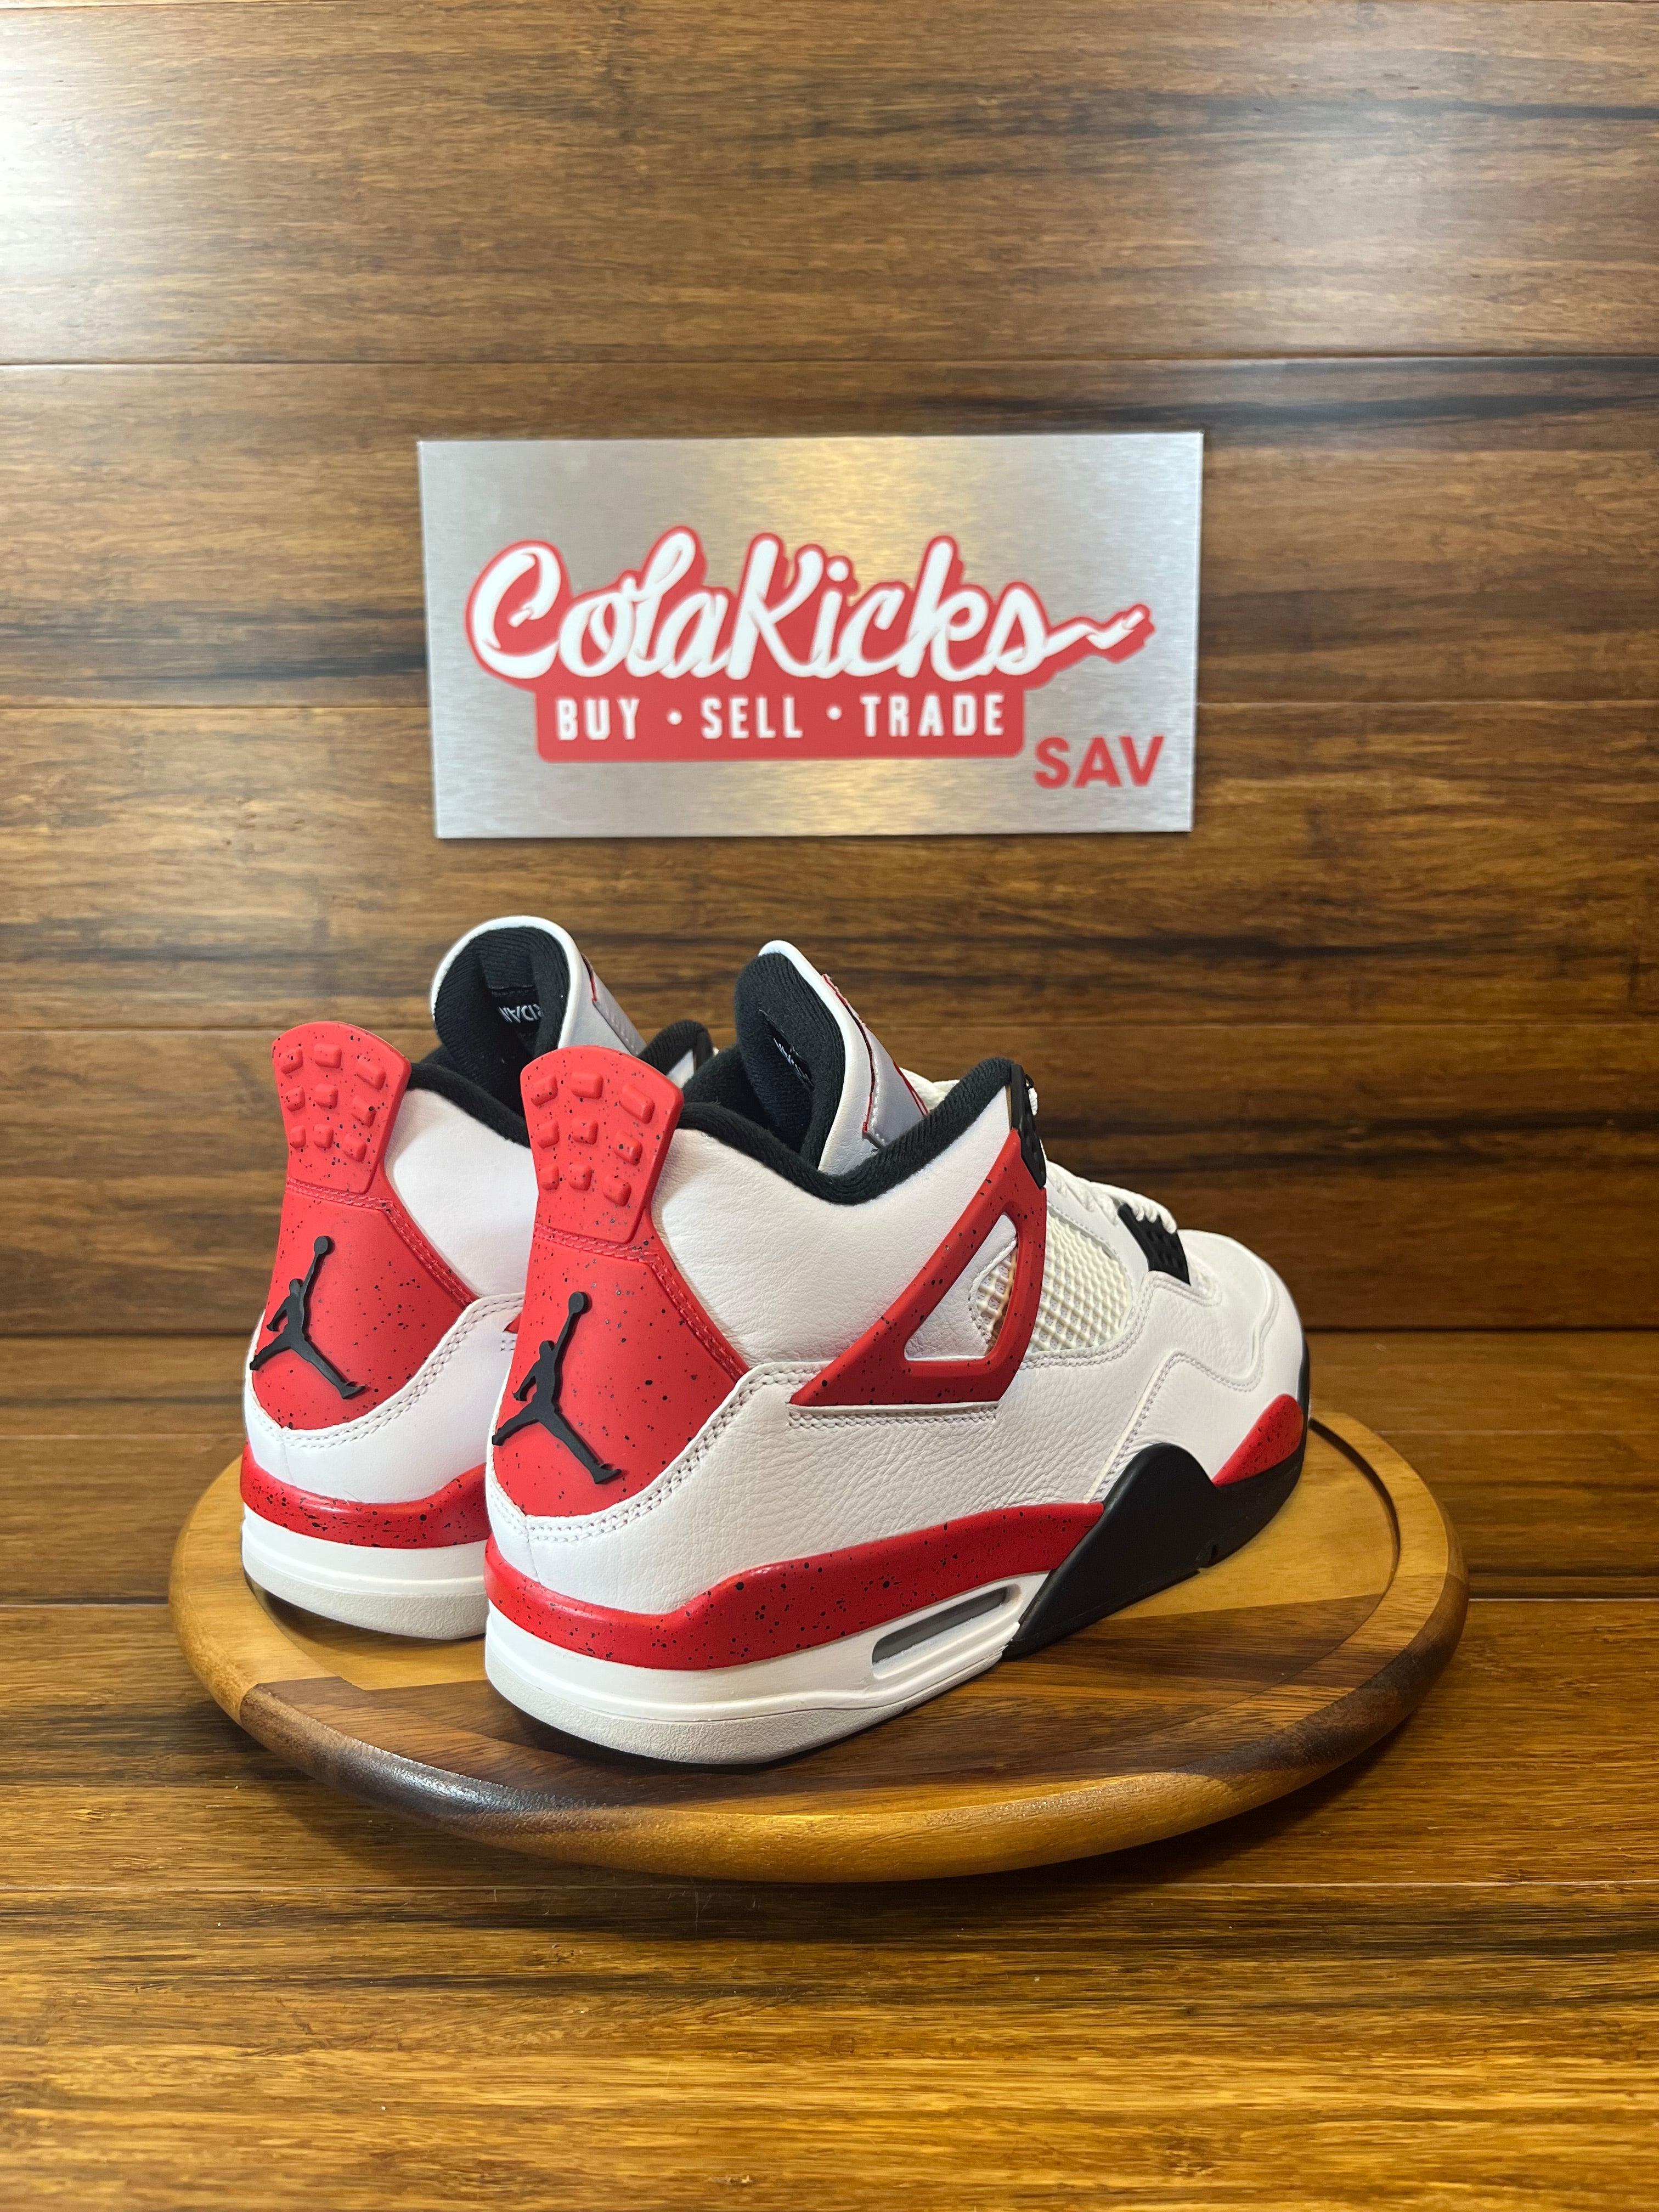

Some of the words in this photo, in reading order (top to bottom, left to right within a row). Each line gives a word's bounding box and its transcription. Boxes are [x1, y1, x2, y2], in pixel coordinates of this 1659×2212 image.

[471, 532, 1145, 681] ColaKicks
[556, 697, 640, 741] BUY
[701, 696, 803, 740] SELL
[860, 693, 1005, 737] TRADE
[1034, 735, 1165, 789] SAV
